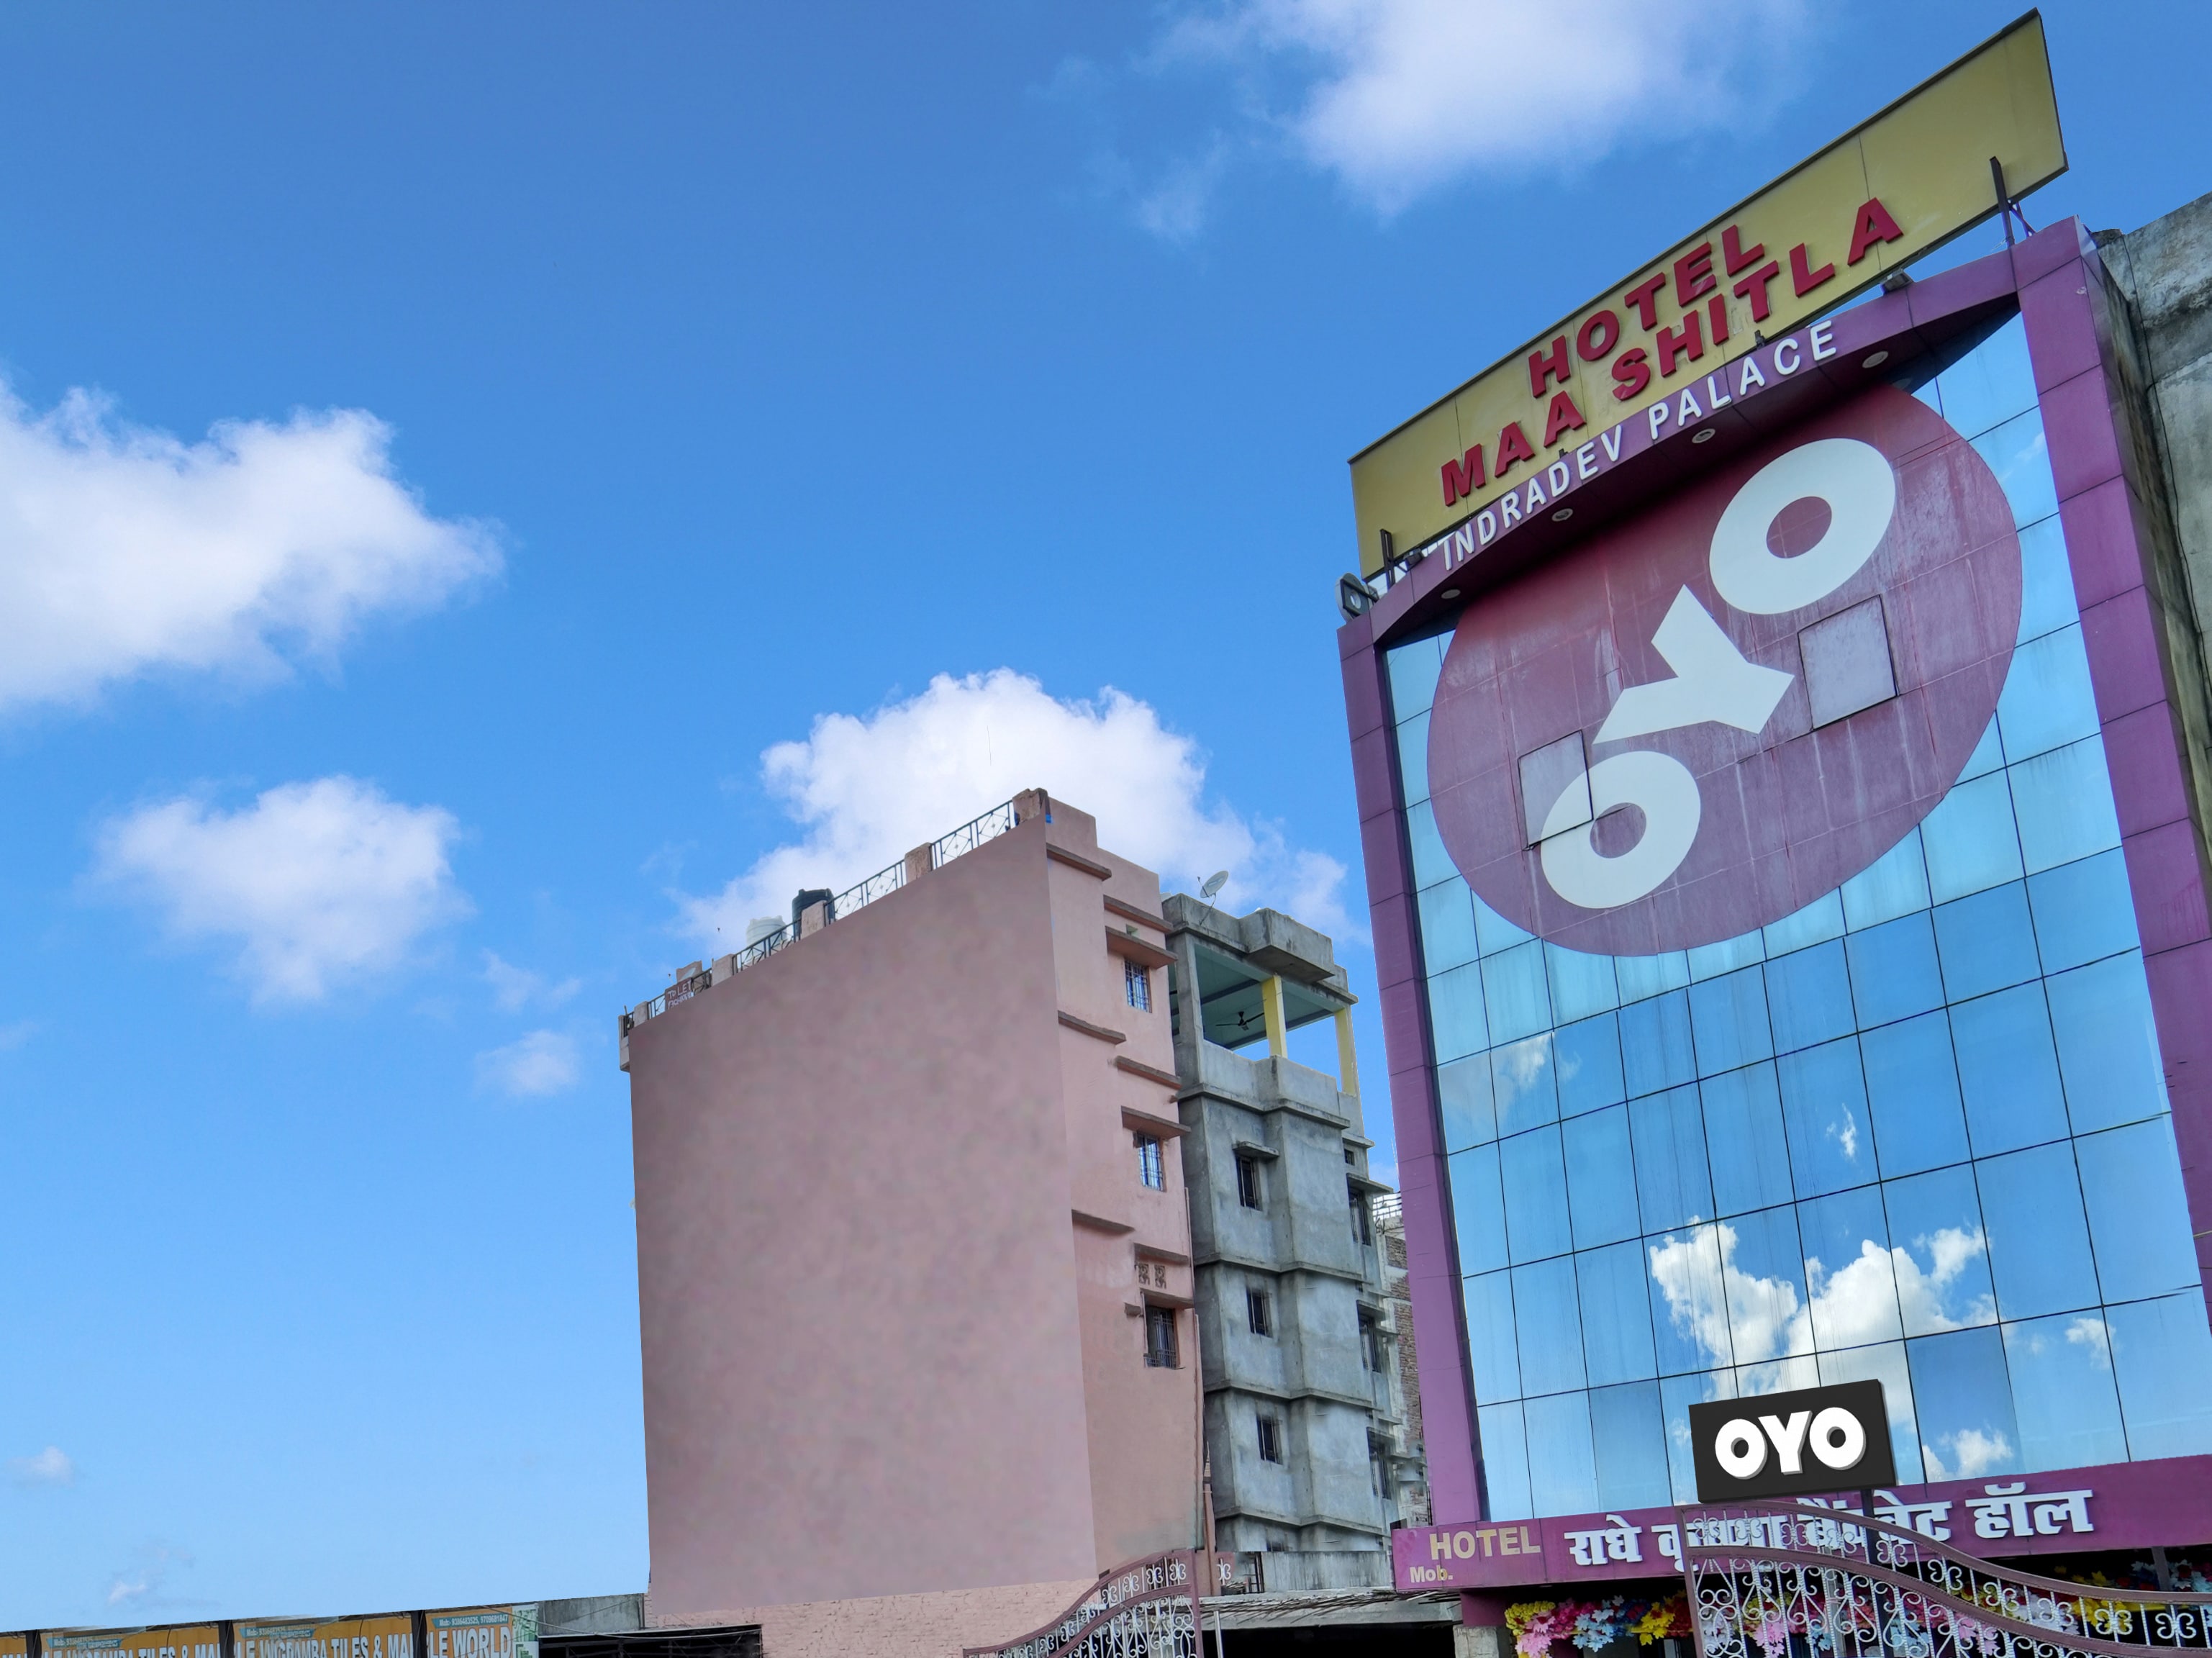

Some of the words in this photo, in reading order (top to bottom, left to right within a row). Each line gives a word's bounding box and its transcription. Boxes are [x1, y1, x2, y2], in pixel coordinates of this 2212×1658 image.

[1441, 390, 1587, 507] MAA
[1611, 197, 1904, 401] SHITLA
[1528, 225, 1764, 398] HOTEL
[1442, 425, 1623, 571] INDRADEV
[1647, 320, 1837, 440] PALACE
[1541, 438, 1895, 908] OYO
[1715, 1407, 1867, 1480] OYO
[1429, 1526, 1541, 1561] HOTEL
[1564, 1514, 1644, 1567] राधे
[1965, 1482, 2095, 1540] हॉल
[1410, 1564, 1454, 1583] Mob.
[452, 1626, 512, 1658] WORLD
